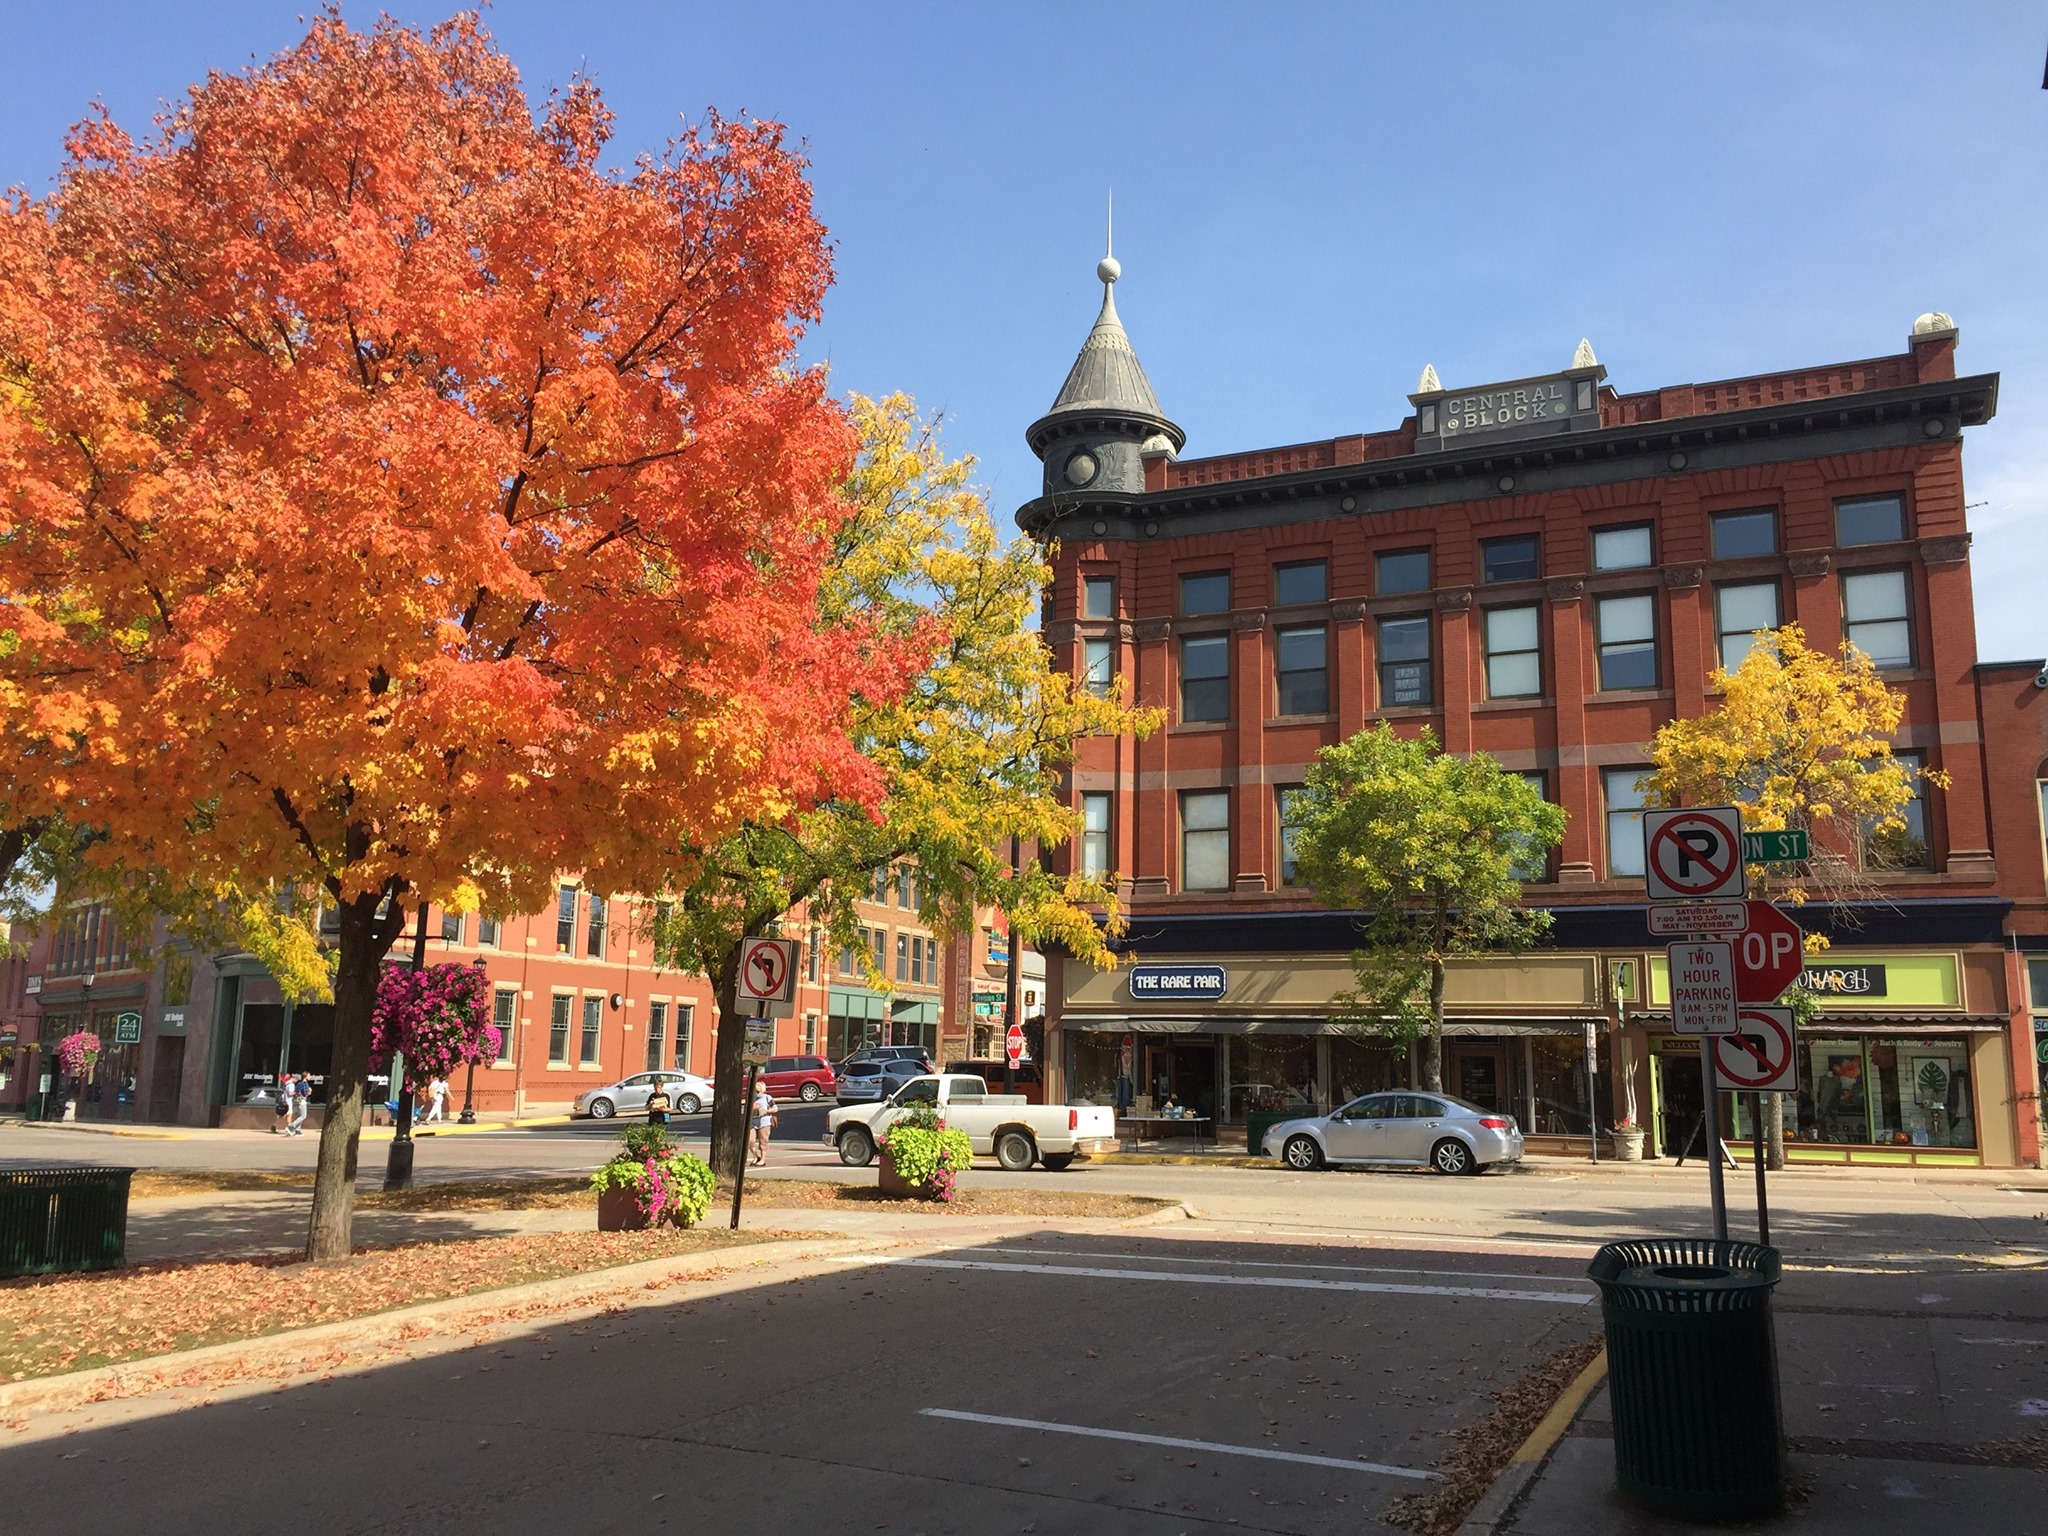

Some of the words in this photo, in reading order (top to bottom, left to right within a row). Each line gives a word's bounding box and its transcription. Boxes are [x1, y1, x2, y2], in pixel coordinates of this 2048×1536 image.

[1449, 385, 1562, 414] CENTRAL
[1464, 403, 1546, 428] BLOCK
[1778, 834, 1799, 857] ST
[1687, 952, 1714, 965] TWO
[1706, 933, 1794, 970] TOP
[1136, 976, 1158, 988] THE
[1160, 975, 1191, 988] RARE
[1193, 975, 1221, 988] PAIR
[1683, 969, 1720, 982] HOUR
[1798, 968, 1870, 992] ONARCH
[1676, 987, 1731, 1001] PARKING
[121, 1018, 137, 1031] 24
[1008, 1036, 1022, 1049] STOP
